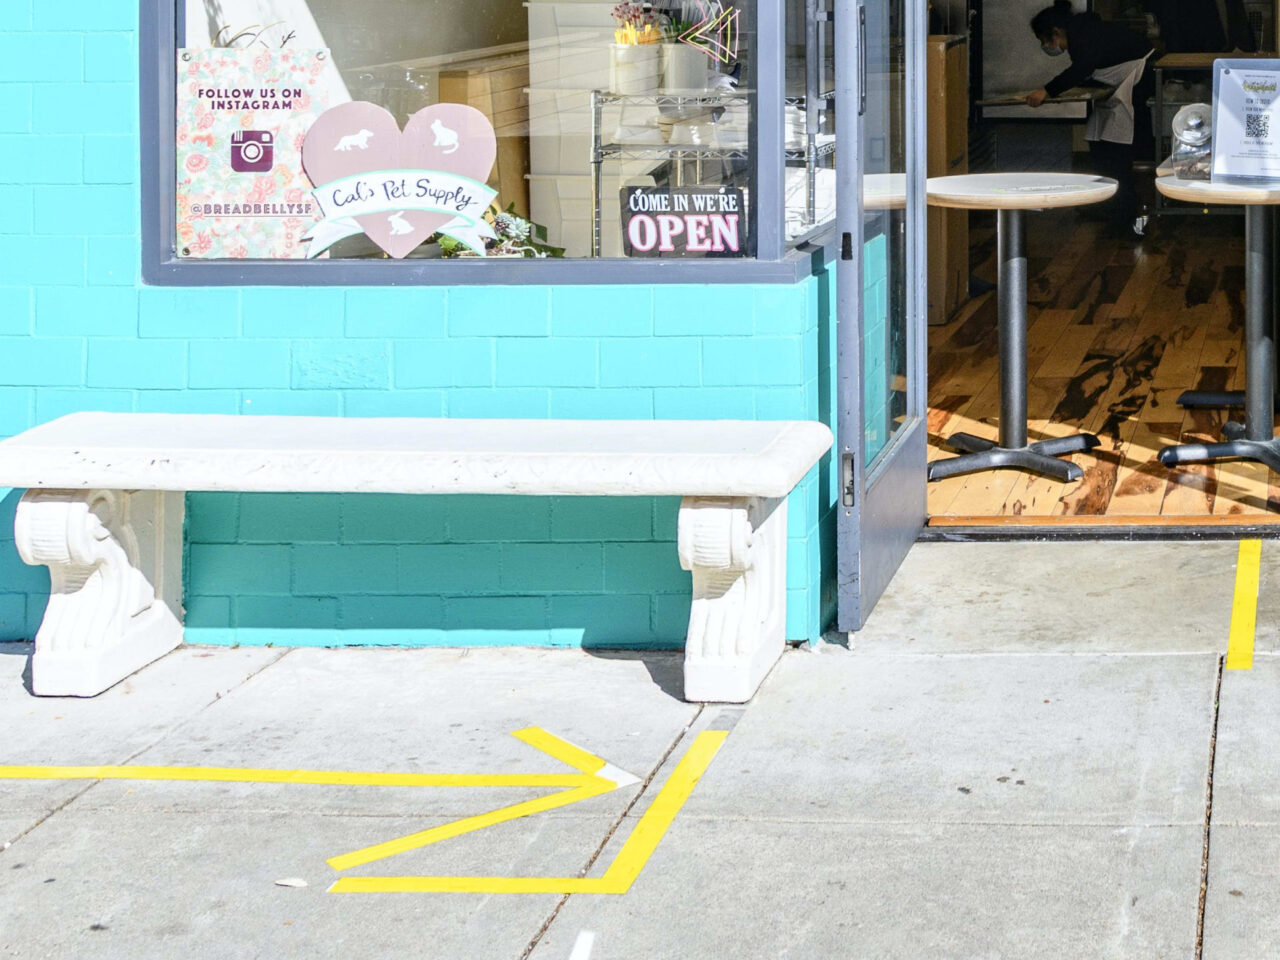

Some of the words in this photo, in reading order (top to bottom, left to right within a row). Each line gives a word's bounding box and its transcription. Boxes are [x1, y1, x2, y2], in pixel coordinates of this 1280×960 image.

[198, 89, 254, 98] FOLLOW
[260, 89, 276, 98] US
[281, 89, 302, 98] ON
[211, 100, 292, 110] INSTAGRAM
[332, 180, 374, 207] Cal's
[382, 179, 406, 199] Pet
[415, 178, 479, 211] Supply
[190, 203, 312, 215] @BREADBELLYSF
[629, 194, 671, 212] COME
[673, 194, 689, 211] IN
[692, 194, 738, 212] WE'RE
[628, 214, 739, 252] OPEN
